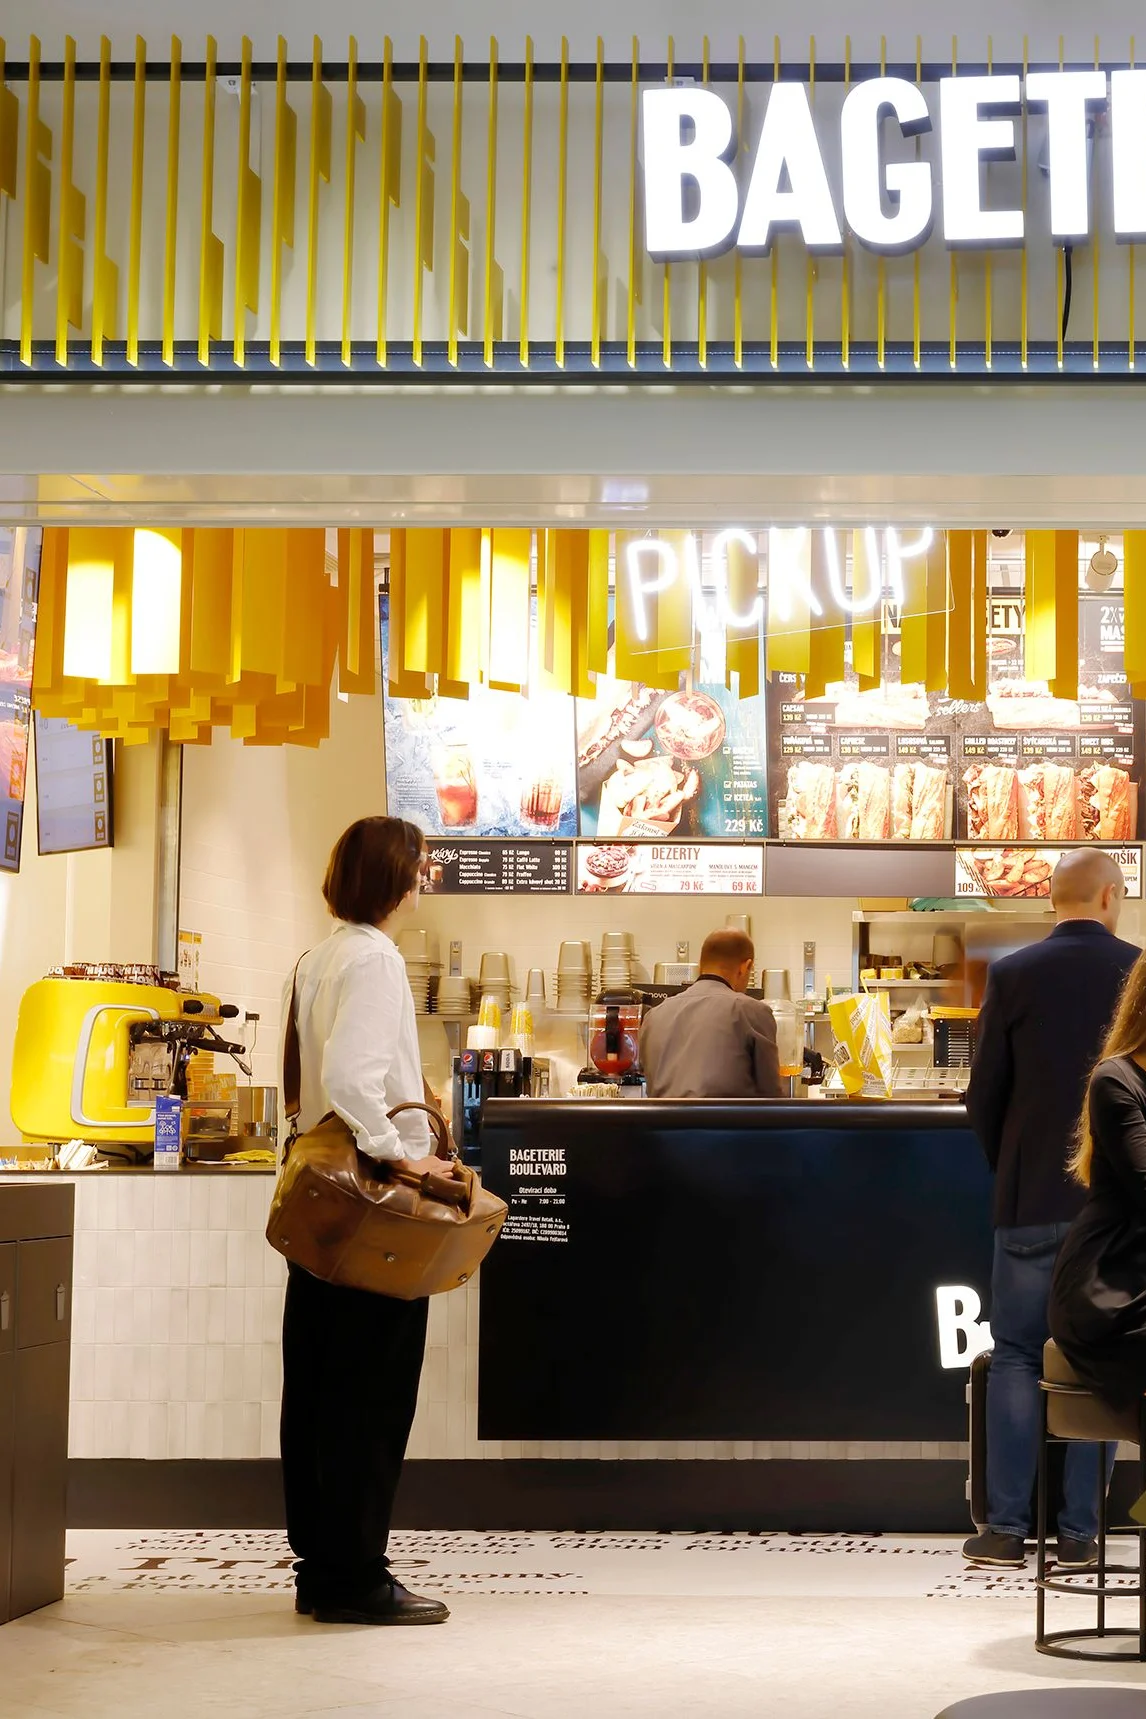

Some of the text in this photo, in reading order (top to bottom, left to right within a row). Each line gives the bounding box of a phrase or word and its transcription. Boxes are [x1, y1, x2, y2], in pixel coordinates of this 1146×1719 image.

[724, 817, 764, 832] 229 Kč
[652, 847, 700, 860] DEZERTY
[680, 880, 704, 891] 79 Kč
[732, 881, 757, 891] 69 Kč
[957, 883, 974, 893] 109
[509, 1149, 566, 1161] BAGETERIE
[509, 1163, 567, 1175] BOULEVARD
